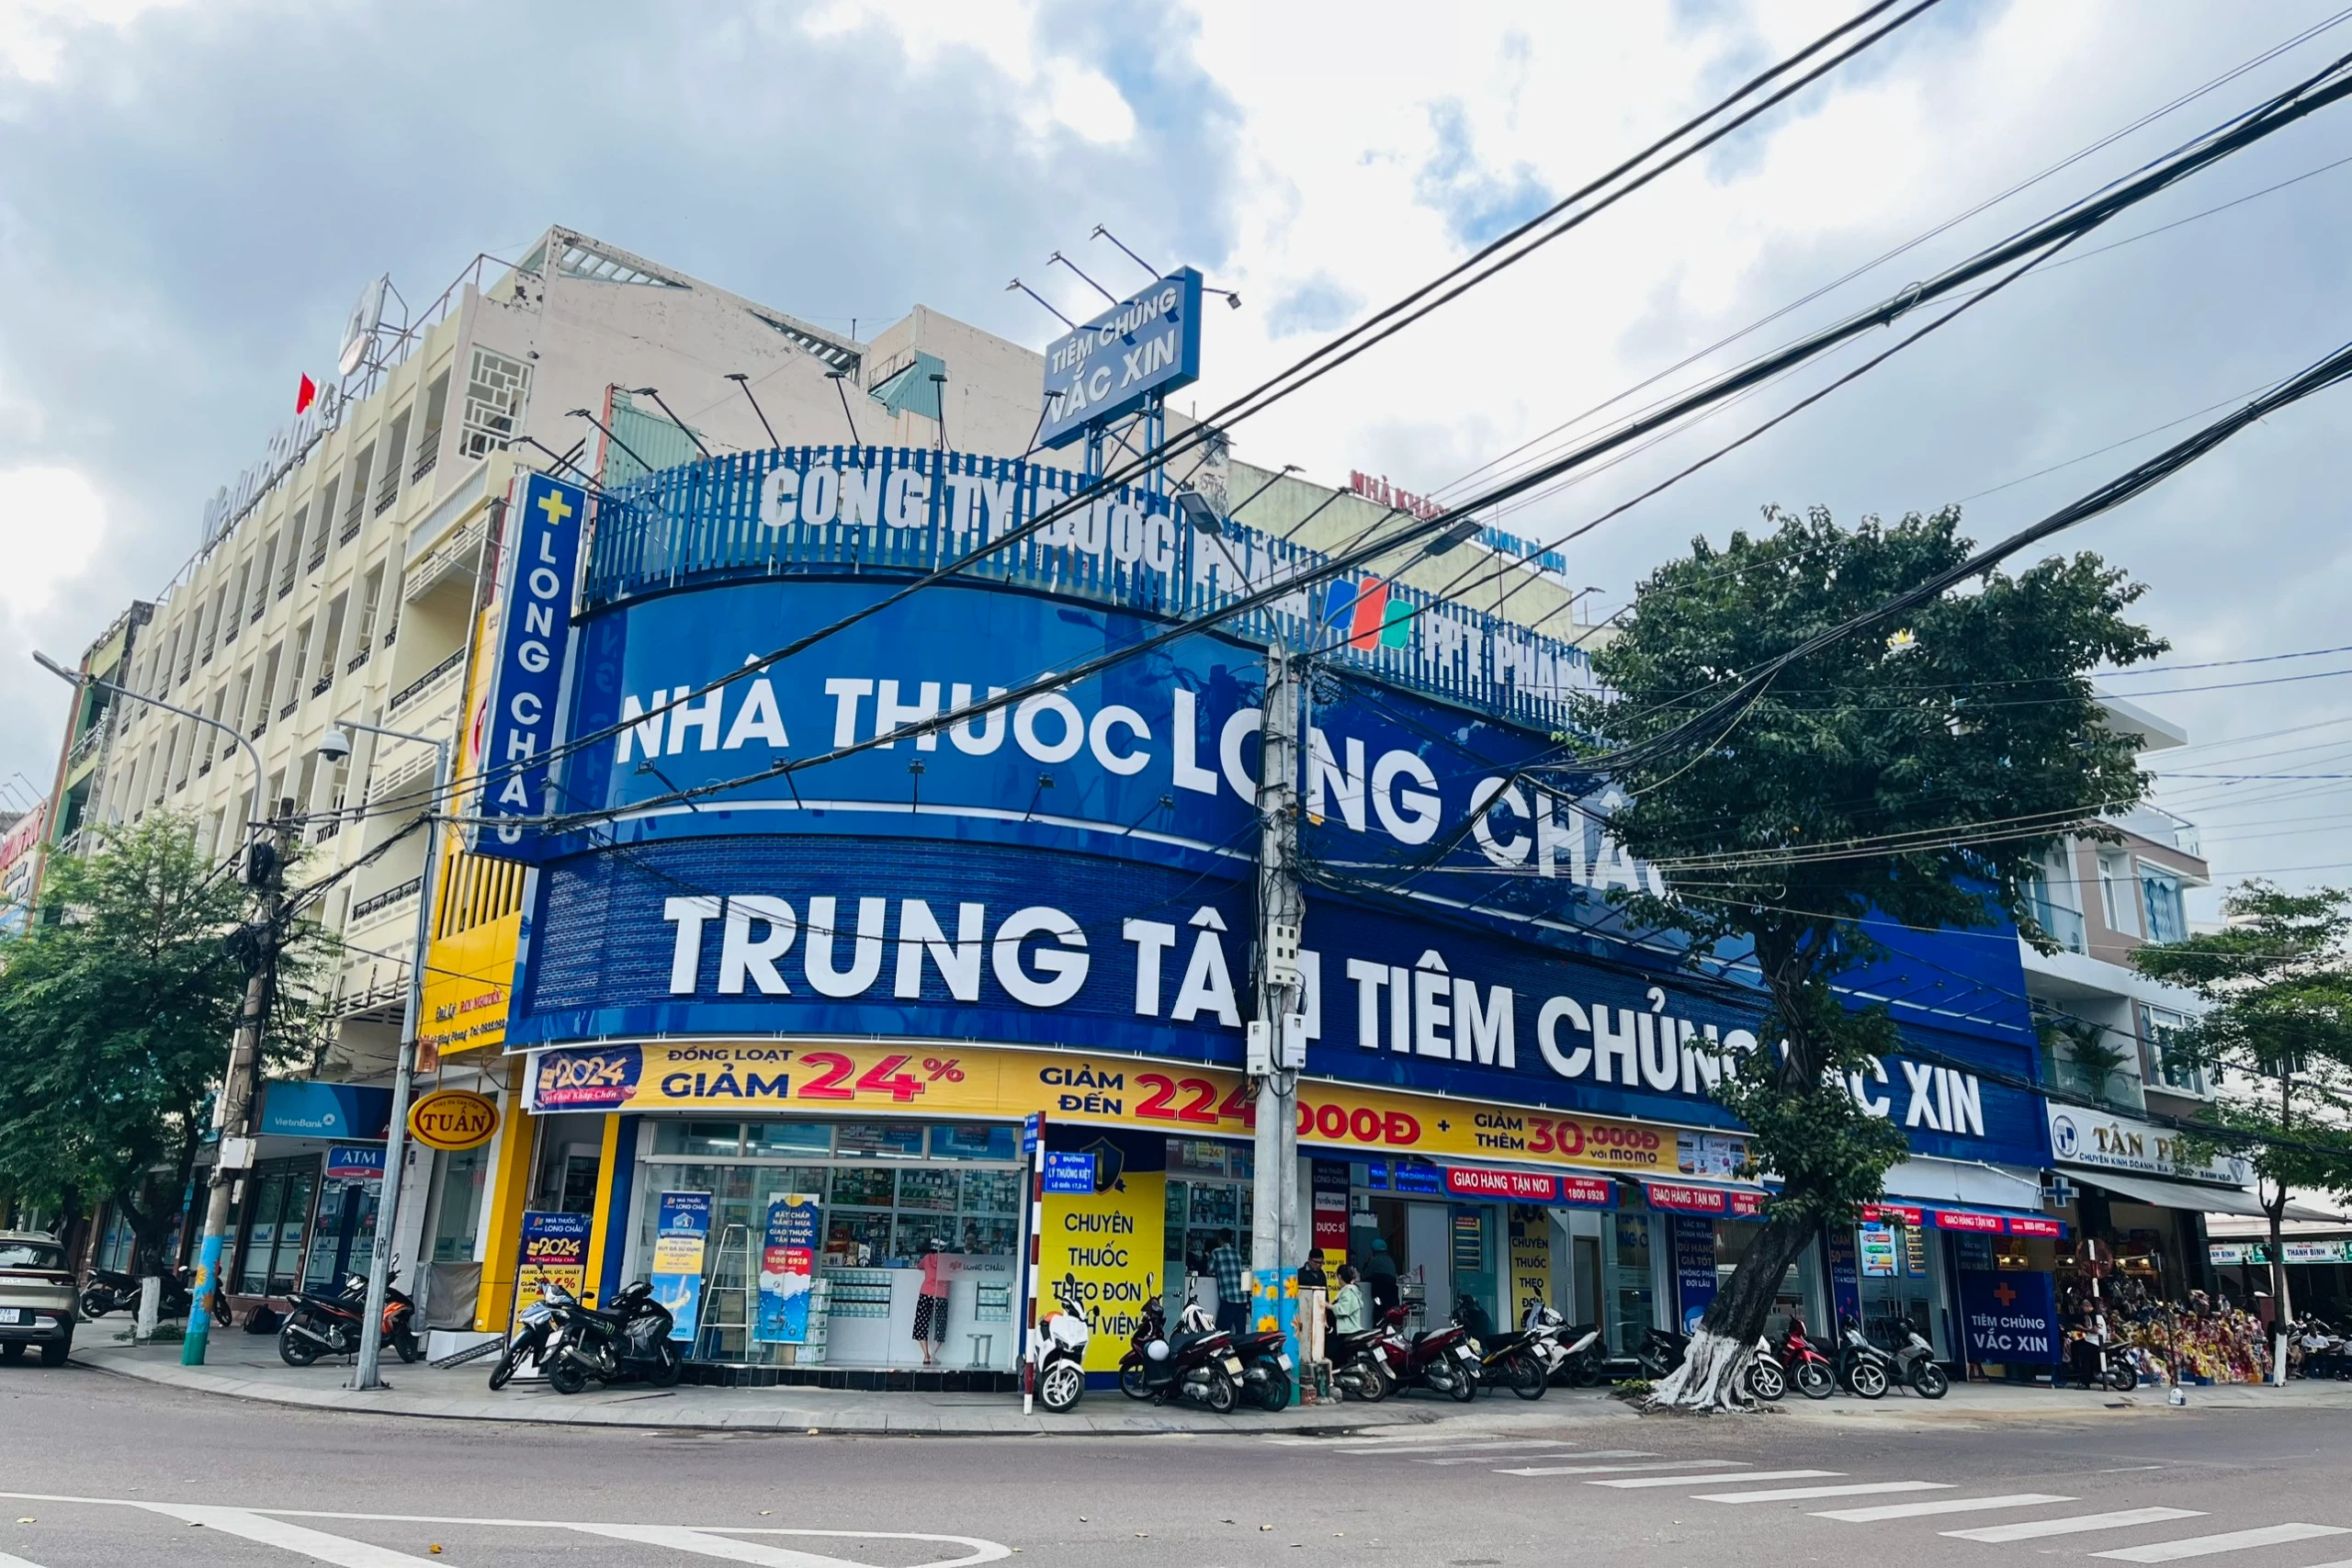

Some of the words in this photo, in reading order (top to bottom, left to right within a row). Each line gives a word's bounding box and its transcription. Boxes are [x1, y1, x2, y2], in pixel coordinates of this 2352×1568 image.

[1052, 333, 1094, 375] TIÊM
[1098, 287, 1177, 347] CHỦNG
[1049, 362, 1113, 424] VẮC
[1120, 329, 1176, 389] XIN
[1351, 469, 1392, 508] NHÀ
[1395, 487, 1450, 521] KHÁC
[945, 474, 1019, 539] TY
[1475, 523, 1522, 559] HANH
[517, 531, 560, 673] LONG
[1424, 611, 1484, 680] FPT
[617, 653, 789, 764] NHÀ
[825, 671, 1151, 776] THUỐC
[496, 691, 542, 845] CHÂU
[664, 894, 1091, 1008] TRUNG
[1346, 950, 1517, 1069] TIÊM
[1900, 1060, 1984, 1137] XIN
[735, 1050, 794, 1064] LOẠT
[556, 1056, 628, 1088] 2024
[661, 1063, 789, 1099] GIẢM
[1039, 1064, 1124, 1091] GIẢM
[1057, 1092, 1124, 1115] ĐẾN
[275, 1116, 322, 1129] VietinBank
[423, 1105, 486, 1133] TUẤN
[1474, 1110, 1523, 1131] GIẢM
[1475, 1133, 1525, 1150] THÊM
[2092, 1122, 2144, 1157] TÂN
[341, 1149, 377, 1165] ATM
[1589, 1149, 1608, 1159] với
[1609, 1148, 1658, 1164] momo
[2079, 1152, 2109, 1164] CHUYÊN
[2110, 1157, 2128, 1168] KINH
[1314, 1175, 1331, 1183] LONG
[1453, 1171, 1479, 1188] GIAO
[1480, 1170, 1509, 1190] HÀNG
[1511, 1174, 1531, 1194] TẬN
[1532, 1178, 1550, 1193] NƠI
[1567, 1188, 1586, 1200] 1800
[1587, 1190, 1605, 1201] 6928
[1653, 1187, 1670, 1201] GIAO
[1671, 1186, 1691, 1203] HÀNG
[1693, 1191, 1708, 1208] TẬN
[1709, 1193, 1721, 1206] NƠI
[1734, 1201, 1747, 1212] 1800
[564, 1224, 583, 1233] CHÂU
[789, 1227, 813, 1236] THUỐC
[1064, 1210, 1134, 1235] CHUYÊN
[1317, 1222, 1338, 1235] DƯỢC
[1944, 1214, 1958, 1224] GIAO
[1958, 1214, 1974, 1226] HÀNG
[1974, 1215, 1986, 1229] TẬN
[538, 1236, 582, 1257] 2024
[1511, 1236, 1549, 1249] CHUYÊN
[2287, 1248, 2307, 1257] THANH
[1068, 1240, 1128, 1268] THUỐC
[1515, 1255, 1547, 1269] THUỐC
[985, 1262, 1006, 1271] CHÂU
[1051, 1280, 1099, 1301] THEO
[1102, 1280, 1142, 1302] ĐƠN
[1519, 1277, 1544, 1288] THEO
[1102, 1311, 1139, 1341] VIỆN
[1971, 1313, 1997, 1327] TIÊM
[2000, 1314, 2046, 1330] CHỦNG
[1973, 1327, 2012, 1350] VẮC
[2017, 1336, 2049, 1352] XIN
